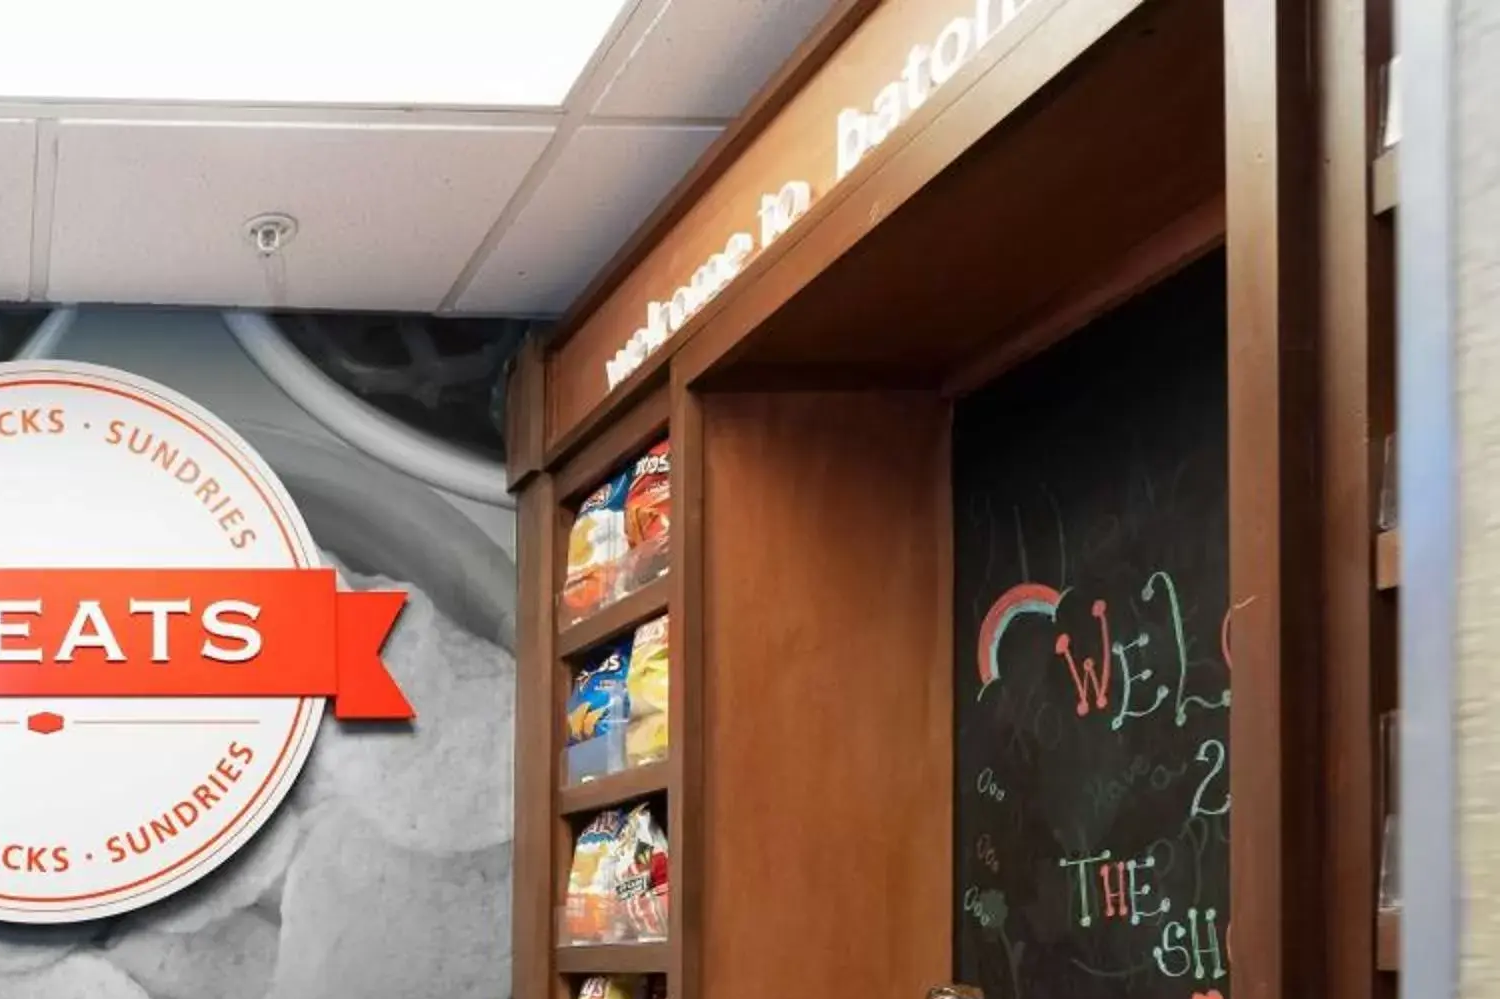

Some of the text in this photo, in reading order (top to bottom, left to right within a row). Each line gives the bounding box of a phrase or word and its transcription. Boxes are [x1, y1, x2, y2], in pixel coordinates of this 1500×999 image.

[757, 180, 811, 250] to
[104, 419, 257, 550] SUNDRIES
[1055, 571, 1233, 731] WEL
[105, 740, 255, 864] SUNDRIES
[1059, 850, 1171, 928] THE
[1153, 908, 1231, 979] SH
